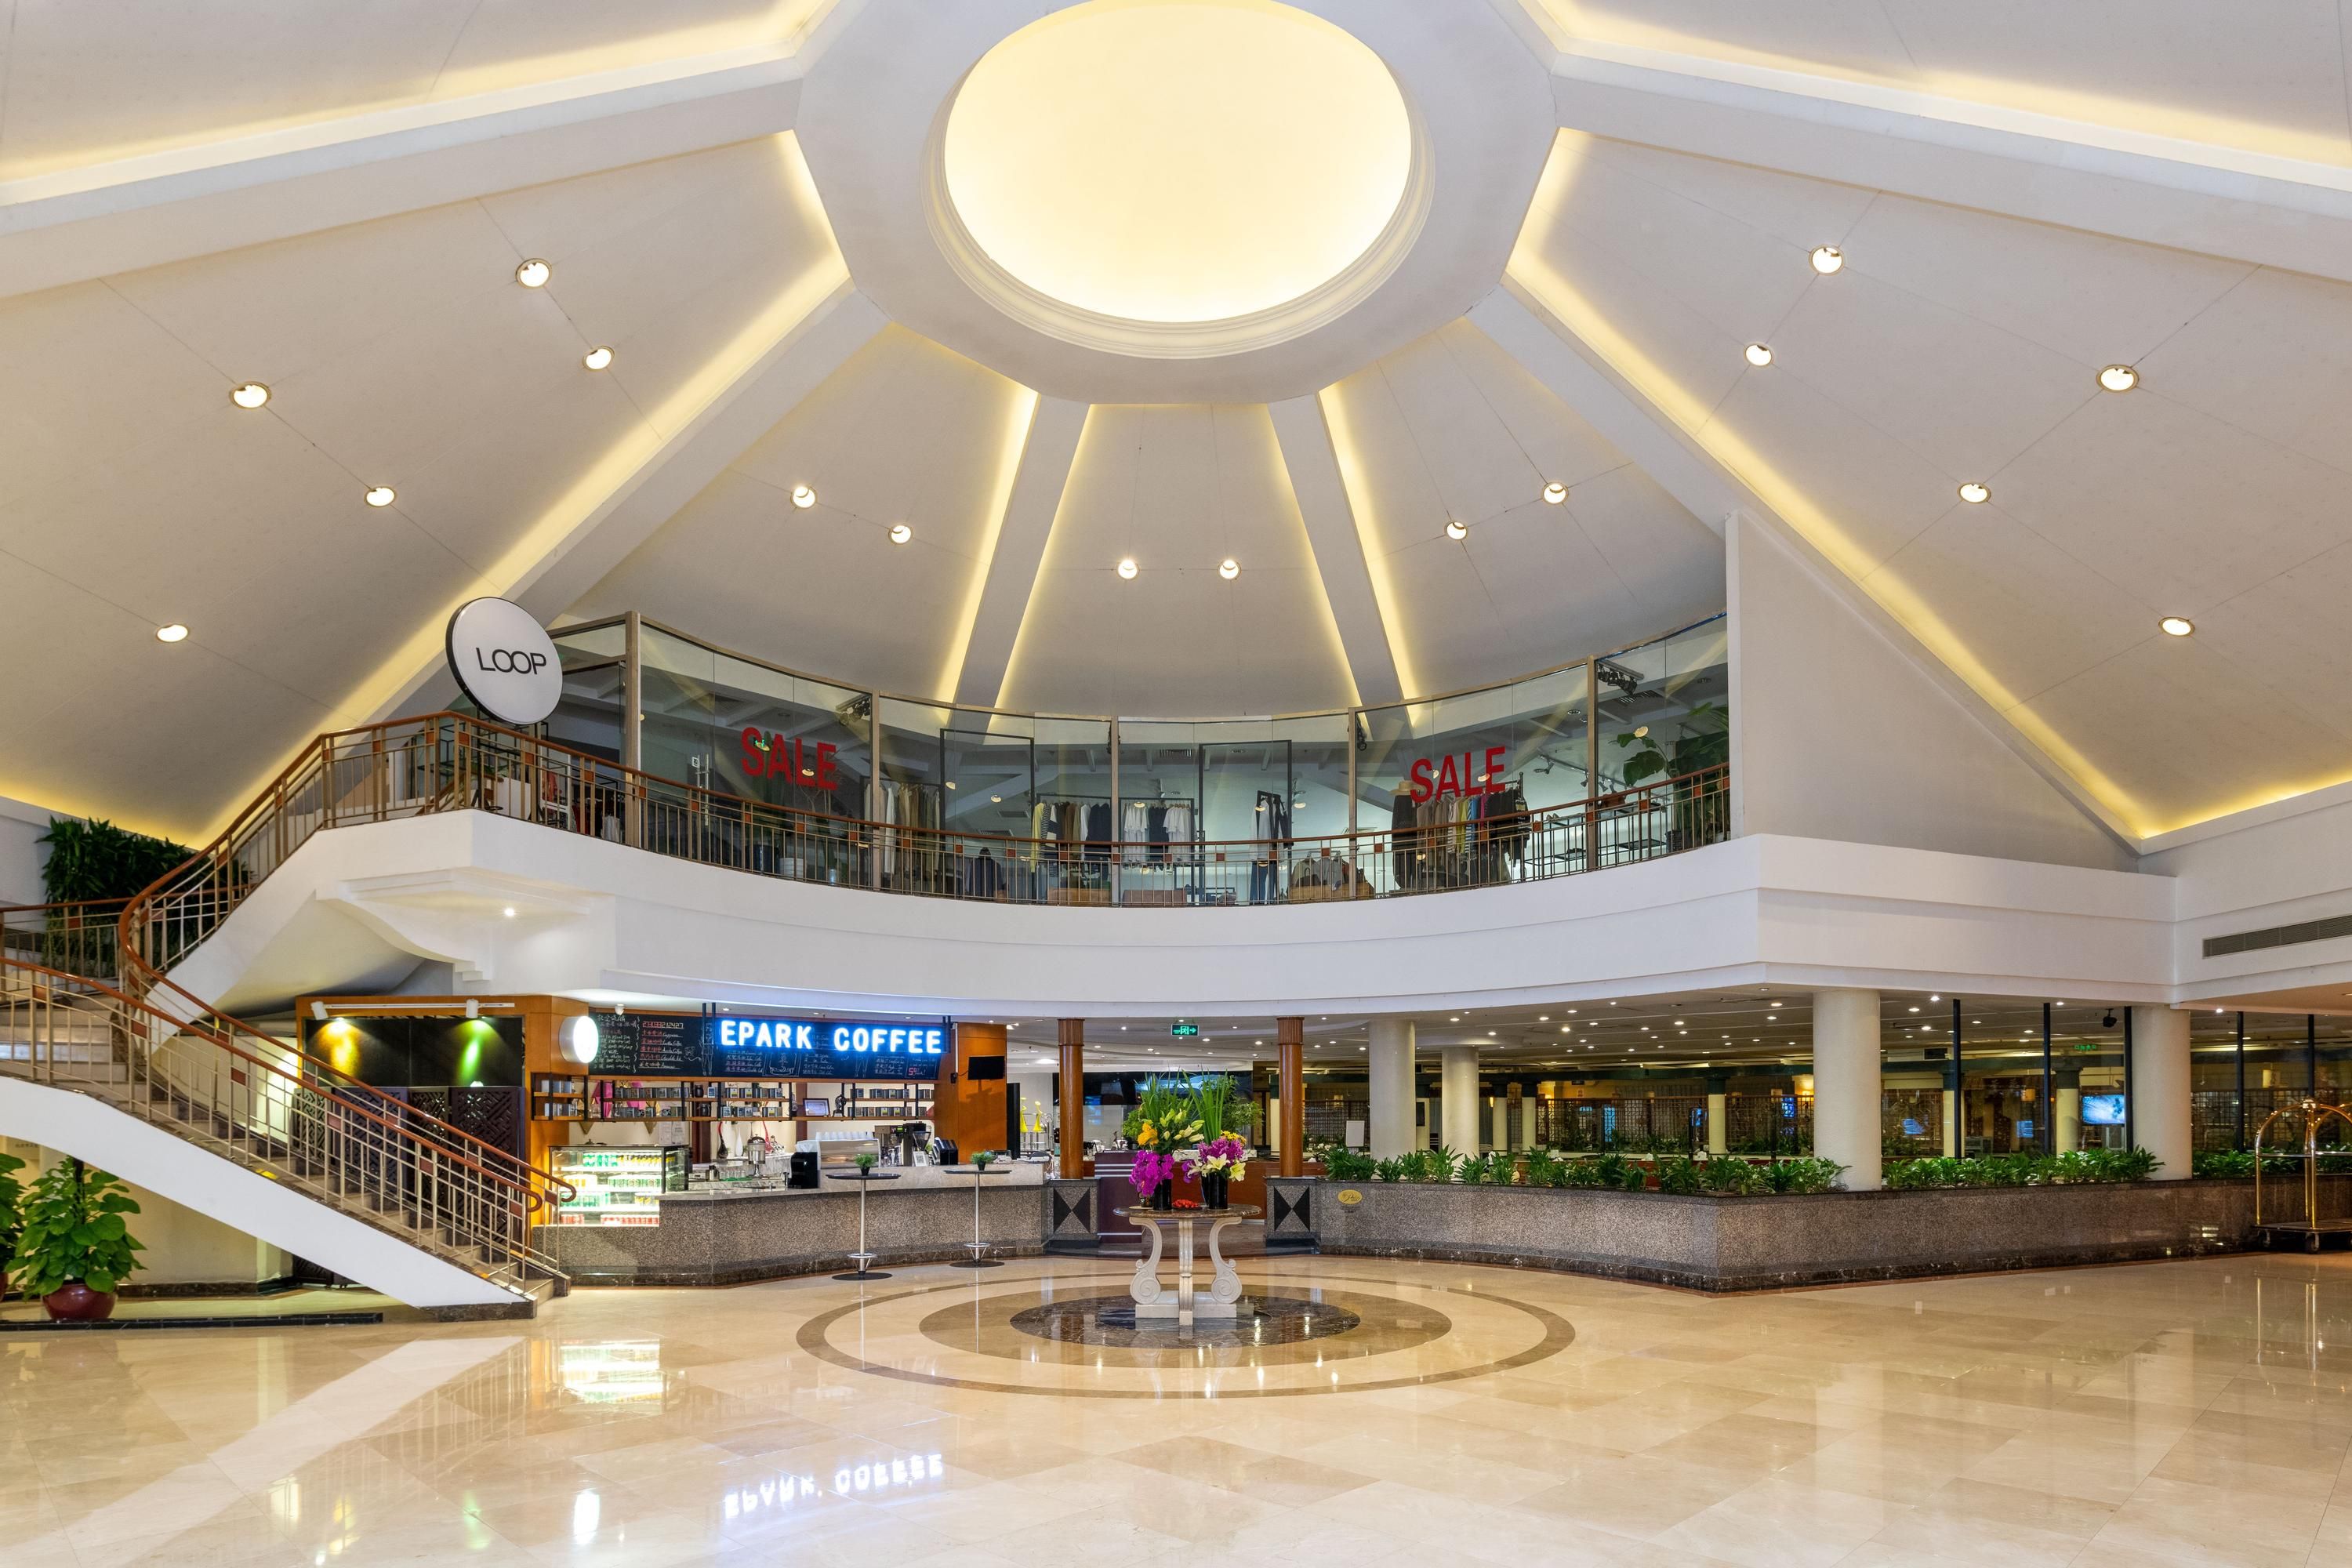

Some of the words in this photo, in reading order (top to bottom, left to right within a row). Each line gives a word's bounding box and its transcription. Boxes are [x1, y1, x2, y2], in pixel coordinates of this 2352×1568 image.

[476, 647, 546, 675] LOOP
[741, 727, 838, 791] SALE
[1410, 746, 1505, 804] SALE
[720, 1019, 812, 1050] EPARK
[833, 1026, 942, 1054] COFFEE
